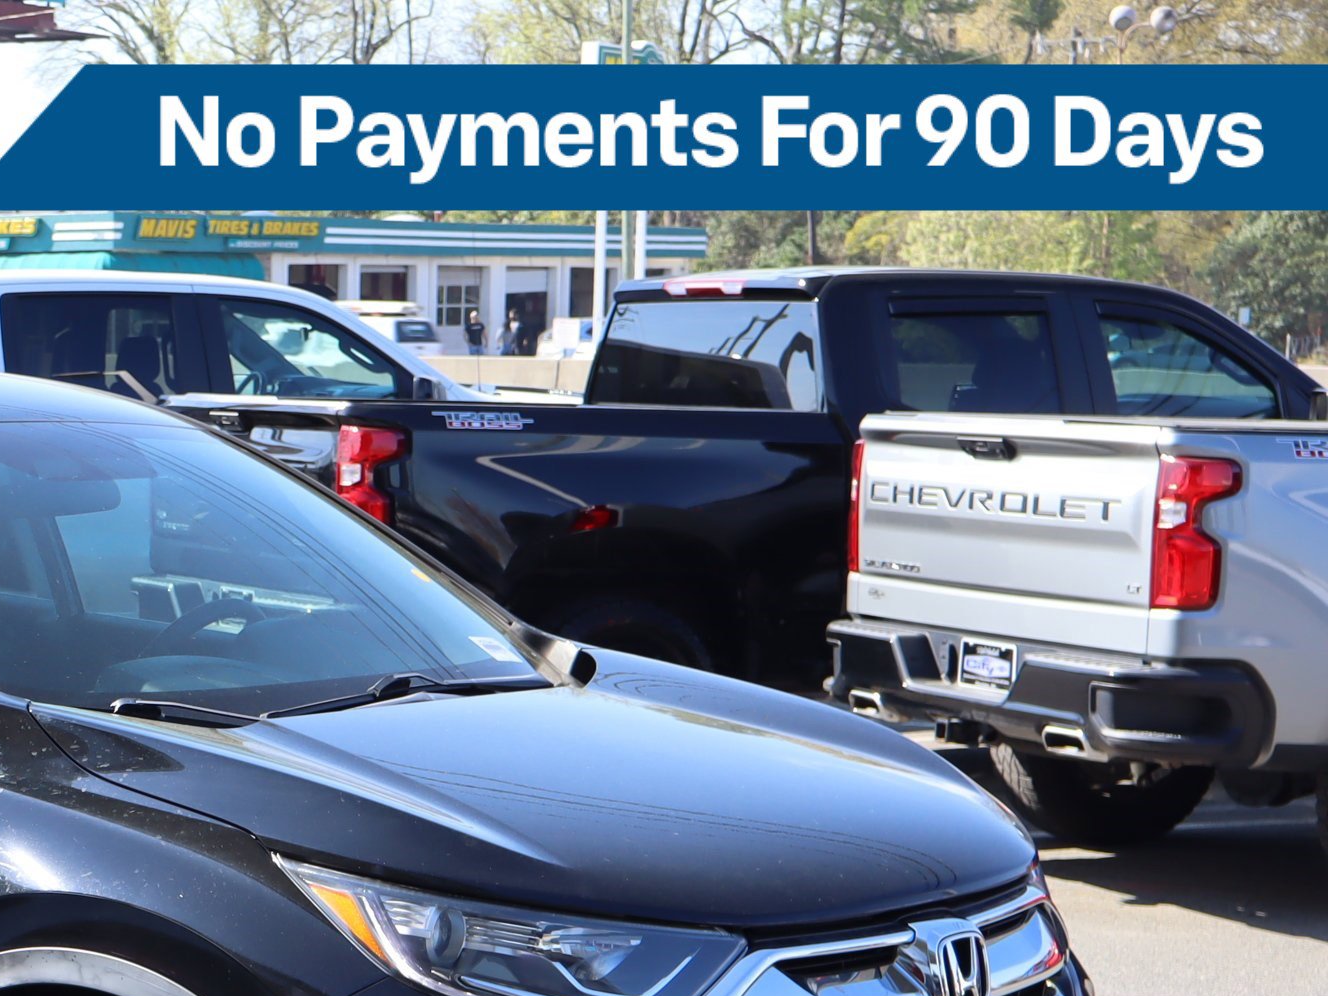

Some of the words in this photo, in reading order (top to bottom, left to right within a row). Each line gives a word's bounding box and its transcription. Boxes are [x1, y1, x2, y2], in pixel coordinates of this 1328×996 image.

[139, 218, 198, 238] MAVIS
[208, 219, 249, 235] TIRES
[263, 221, 320, 236] BRAKES
[871, 480, 1122, 522] CHEVROLET
